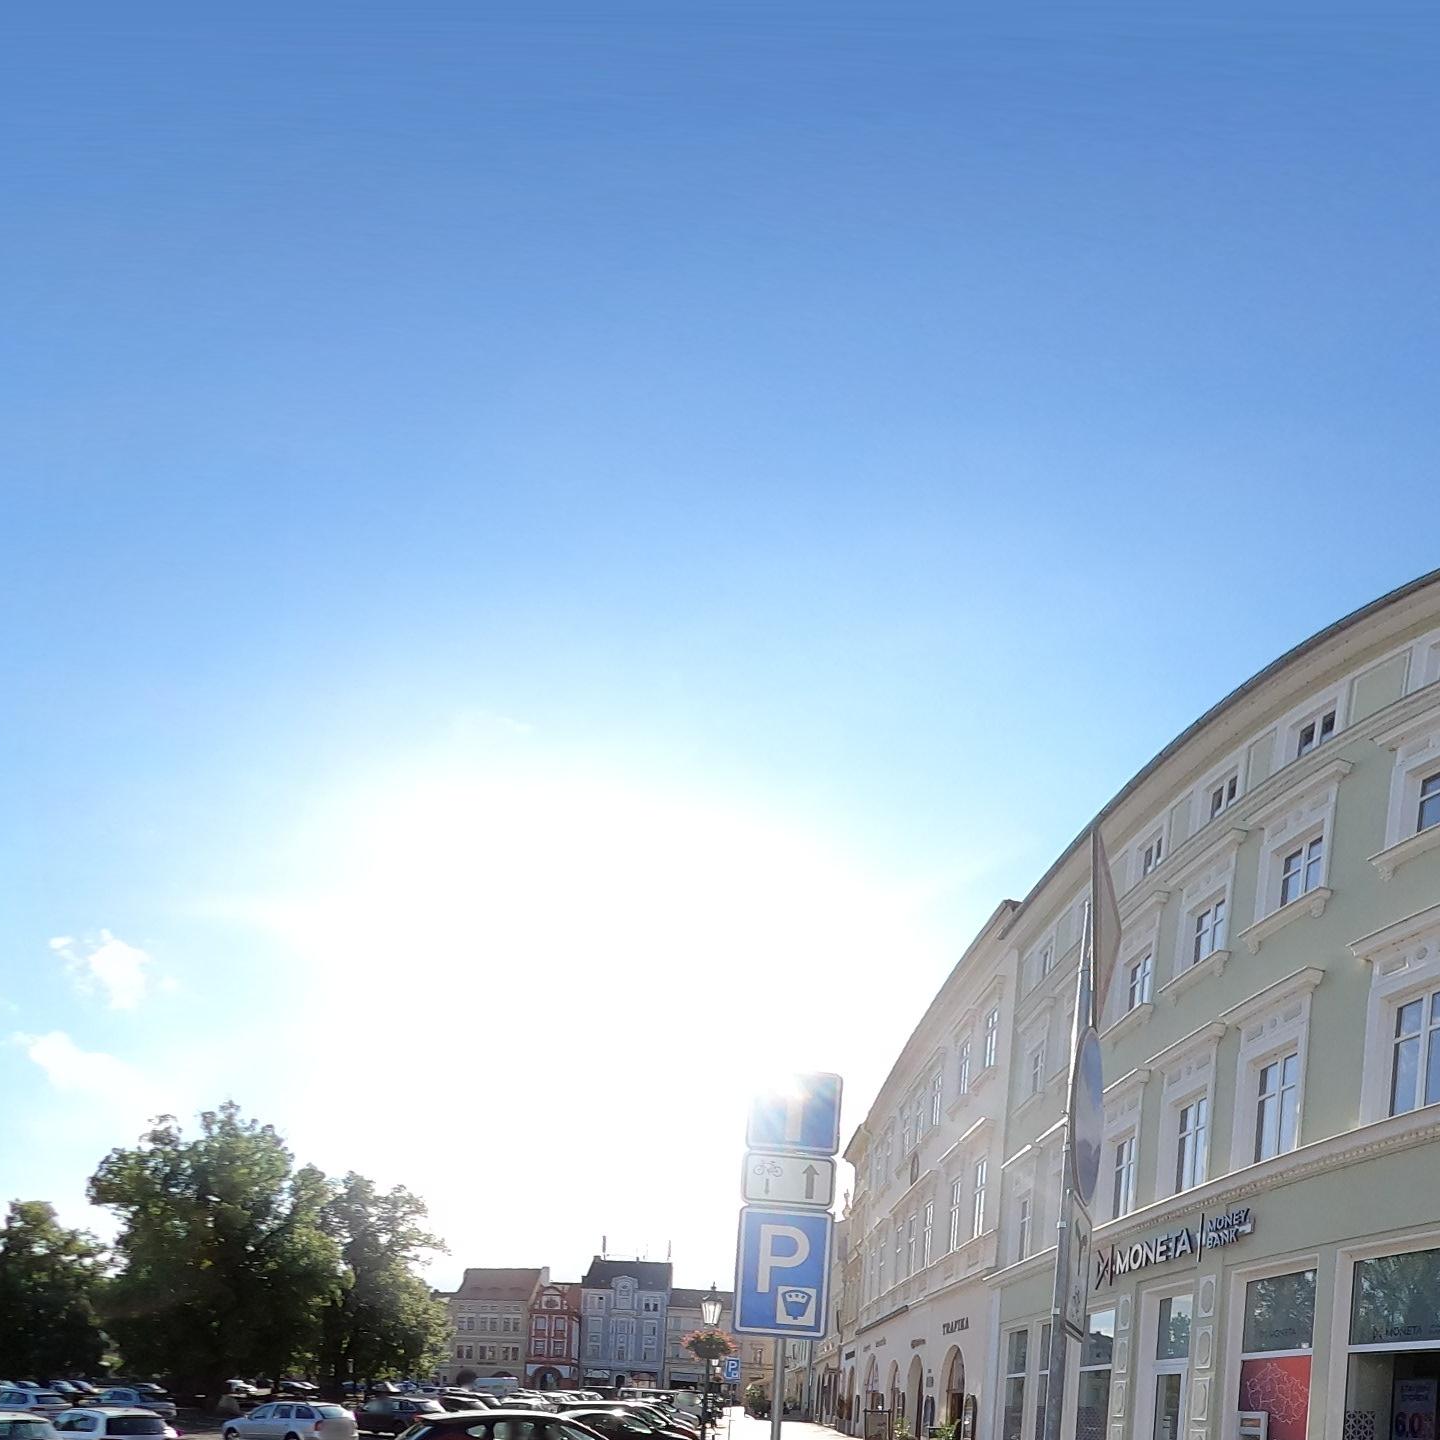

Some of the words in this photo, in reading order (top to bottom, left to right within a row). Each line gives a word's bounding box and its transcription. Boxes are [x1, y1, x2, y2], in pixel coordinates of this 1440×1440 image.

[1207, 1208, 1250, 1231] MONEY
[1206, 1229, 1240, 1249] BANK
[757, 1224, 810, 1293] P
[1115, 1227, 1193, 1276] MONETA
[728, 1361, 737, 1373] P
